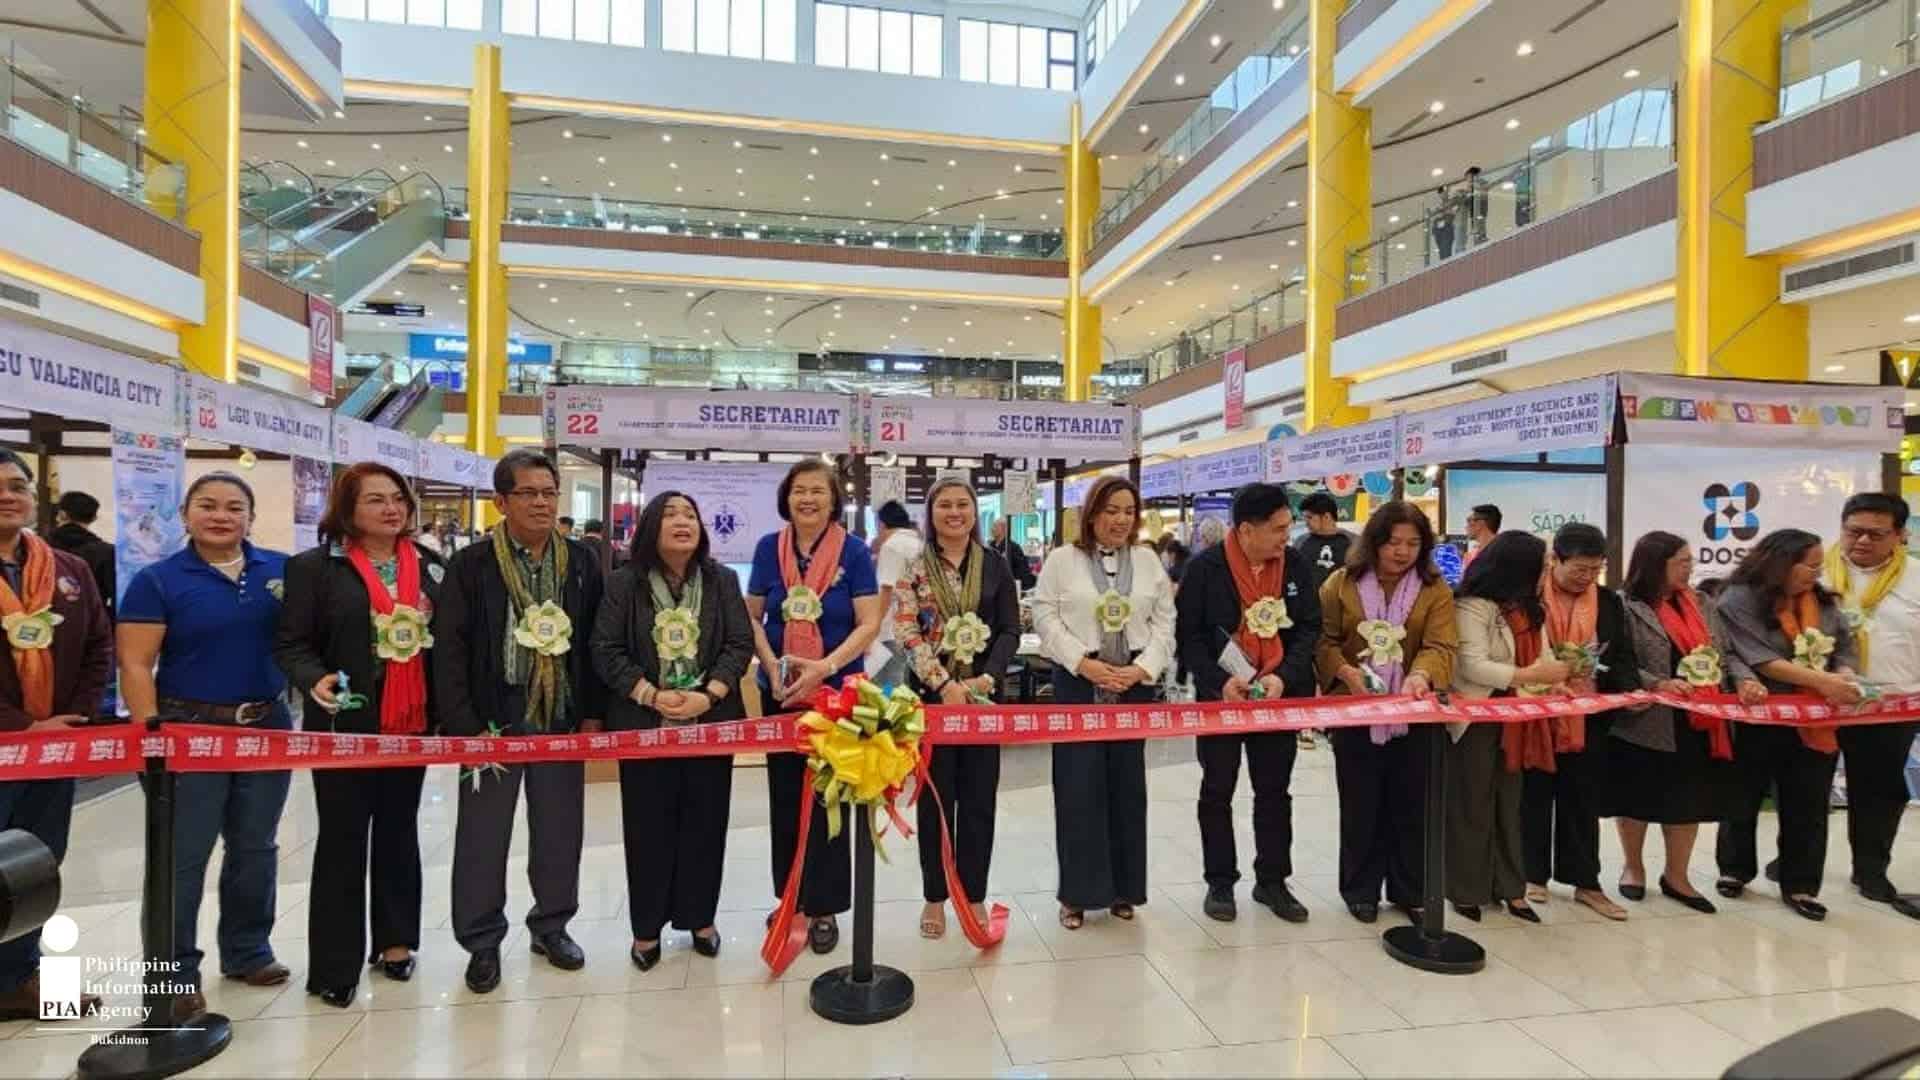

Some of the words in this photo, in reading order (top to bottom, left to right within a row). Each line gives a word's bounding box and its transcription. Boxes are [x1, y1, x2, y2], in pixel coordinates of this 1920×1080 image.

[1899, 357, 1910, 377] 1
[28, 356, 121, 398] VALENCIA
[127, 380, 163, 408] CITY
[1530, 396, 1575, 413] SCIENCE
[1577, 392, 1599, 405] AND
[199, 408, 217, 430] 02
[227, 404, 251, 426] LGU
[253, 410, 301, 437] VALENCIA
[302, 420, 324, 441] CITY
[567, 414, 599, 434] 22
[699, 404, 840, 426] SECRETARIAT
[998, 415, 1124, 434] SECRETARIAT
[1543, 406, 1599, 424] MINDANAO
[881, 422, 906, 442] 21
[1406, 437, 1423, 454] 20
[1700, 547, 1748, 564] DOS
